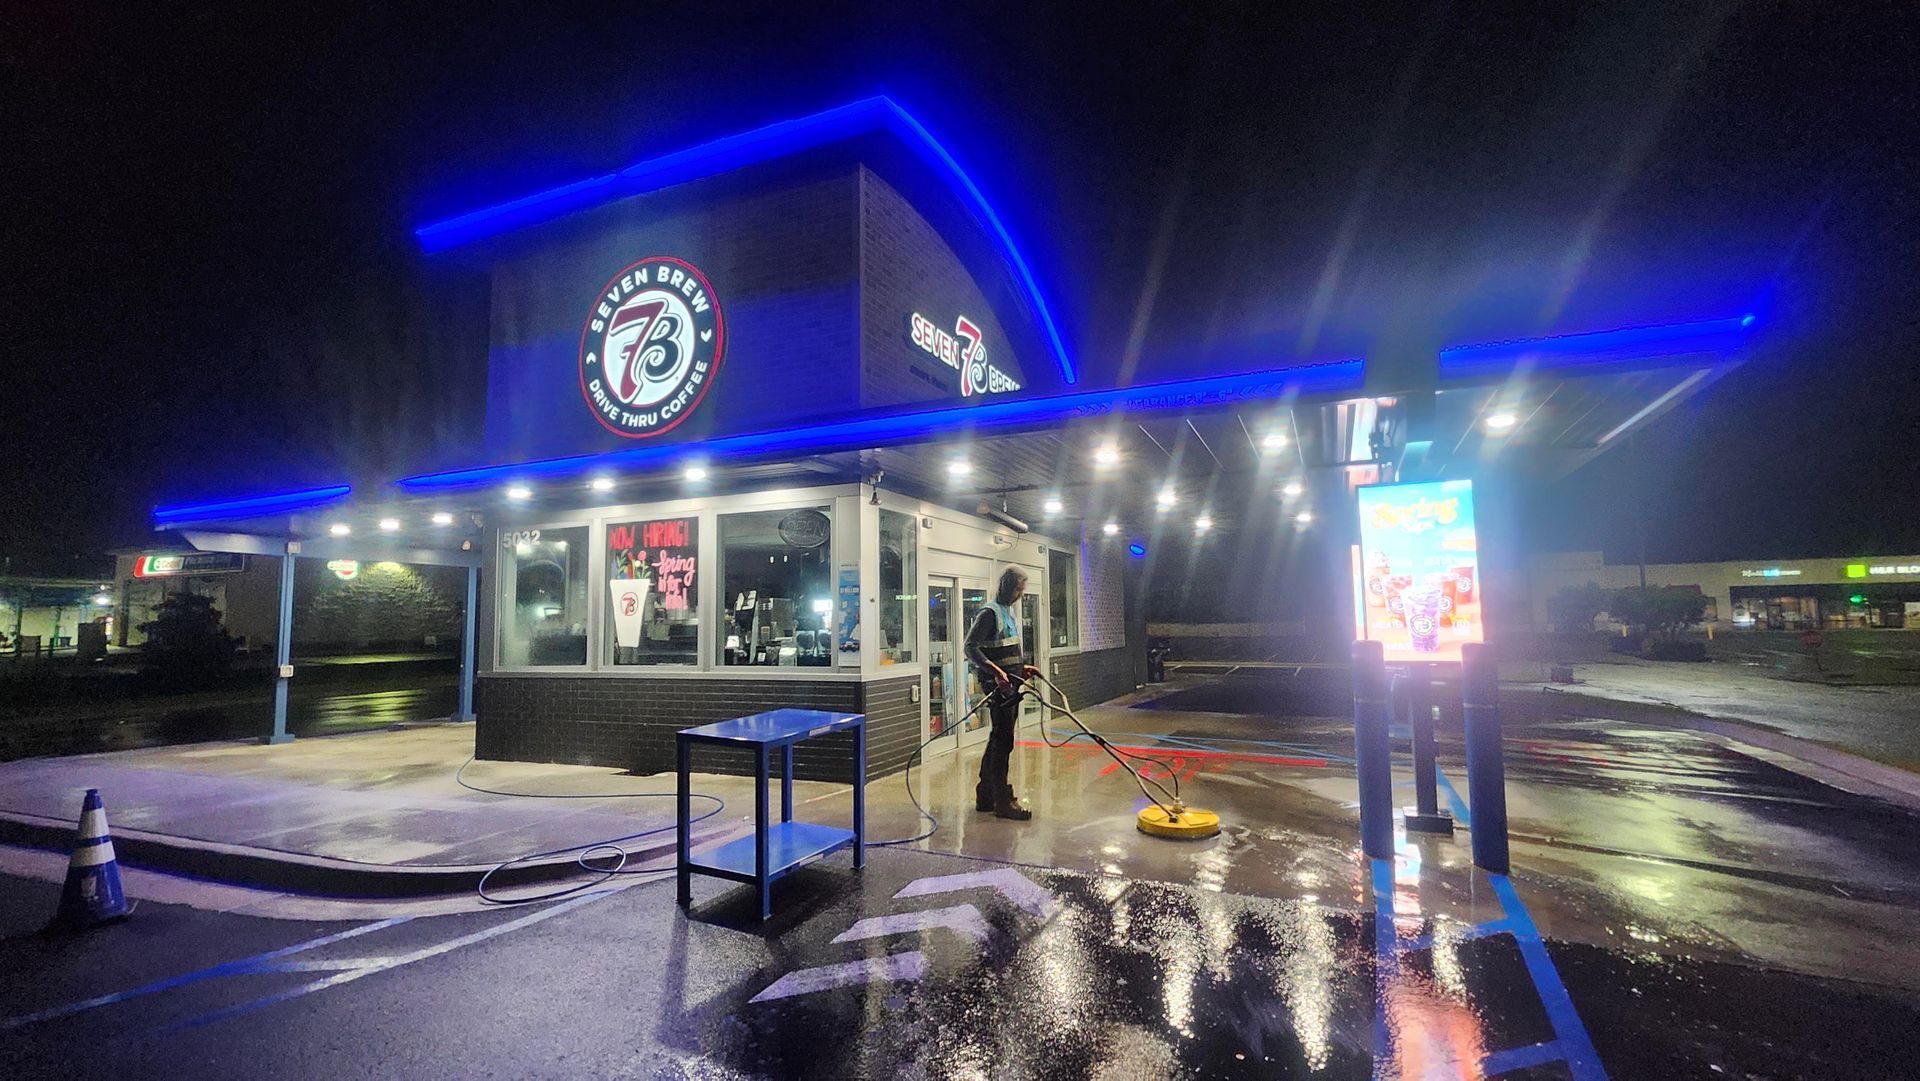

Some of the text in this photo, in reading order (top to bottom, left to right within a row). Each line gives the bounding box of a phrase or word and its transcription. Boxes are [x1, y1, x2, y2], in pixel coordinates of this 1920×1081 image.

[591, 266, 710, 333] SEVEN BREW
[911, 312, 960, 370] SEVEN
[589, 360, 708, 427] DRIVE THRU COFFEE
[503, 530, 541, 548] 5032
[609, 520, 689, 550] NOW HIRING!
[651, 550, 695, 586] Spring
